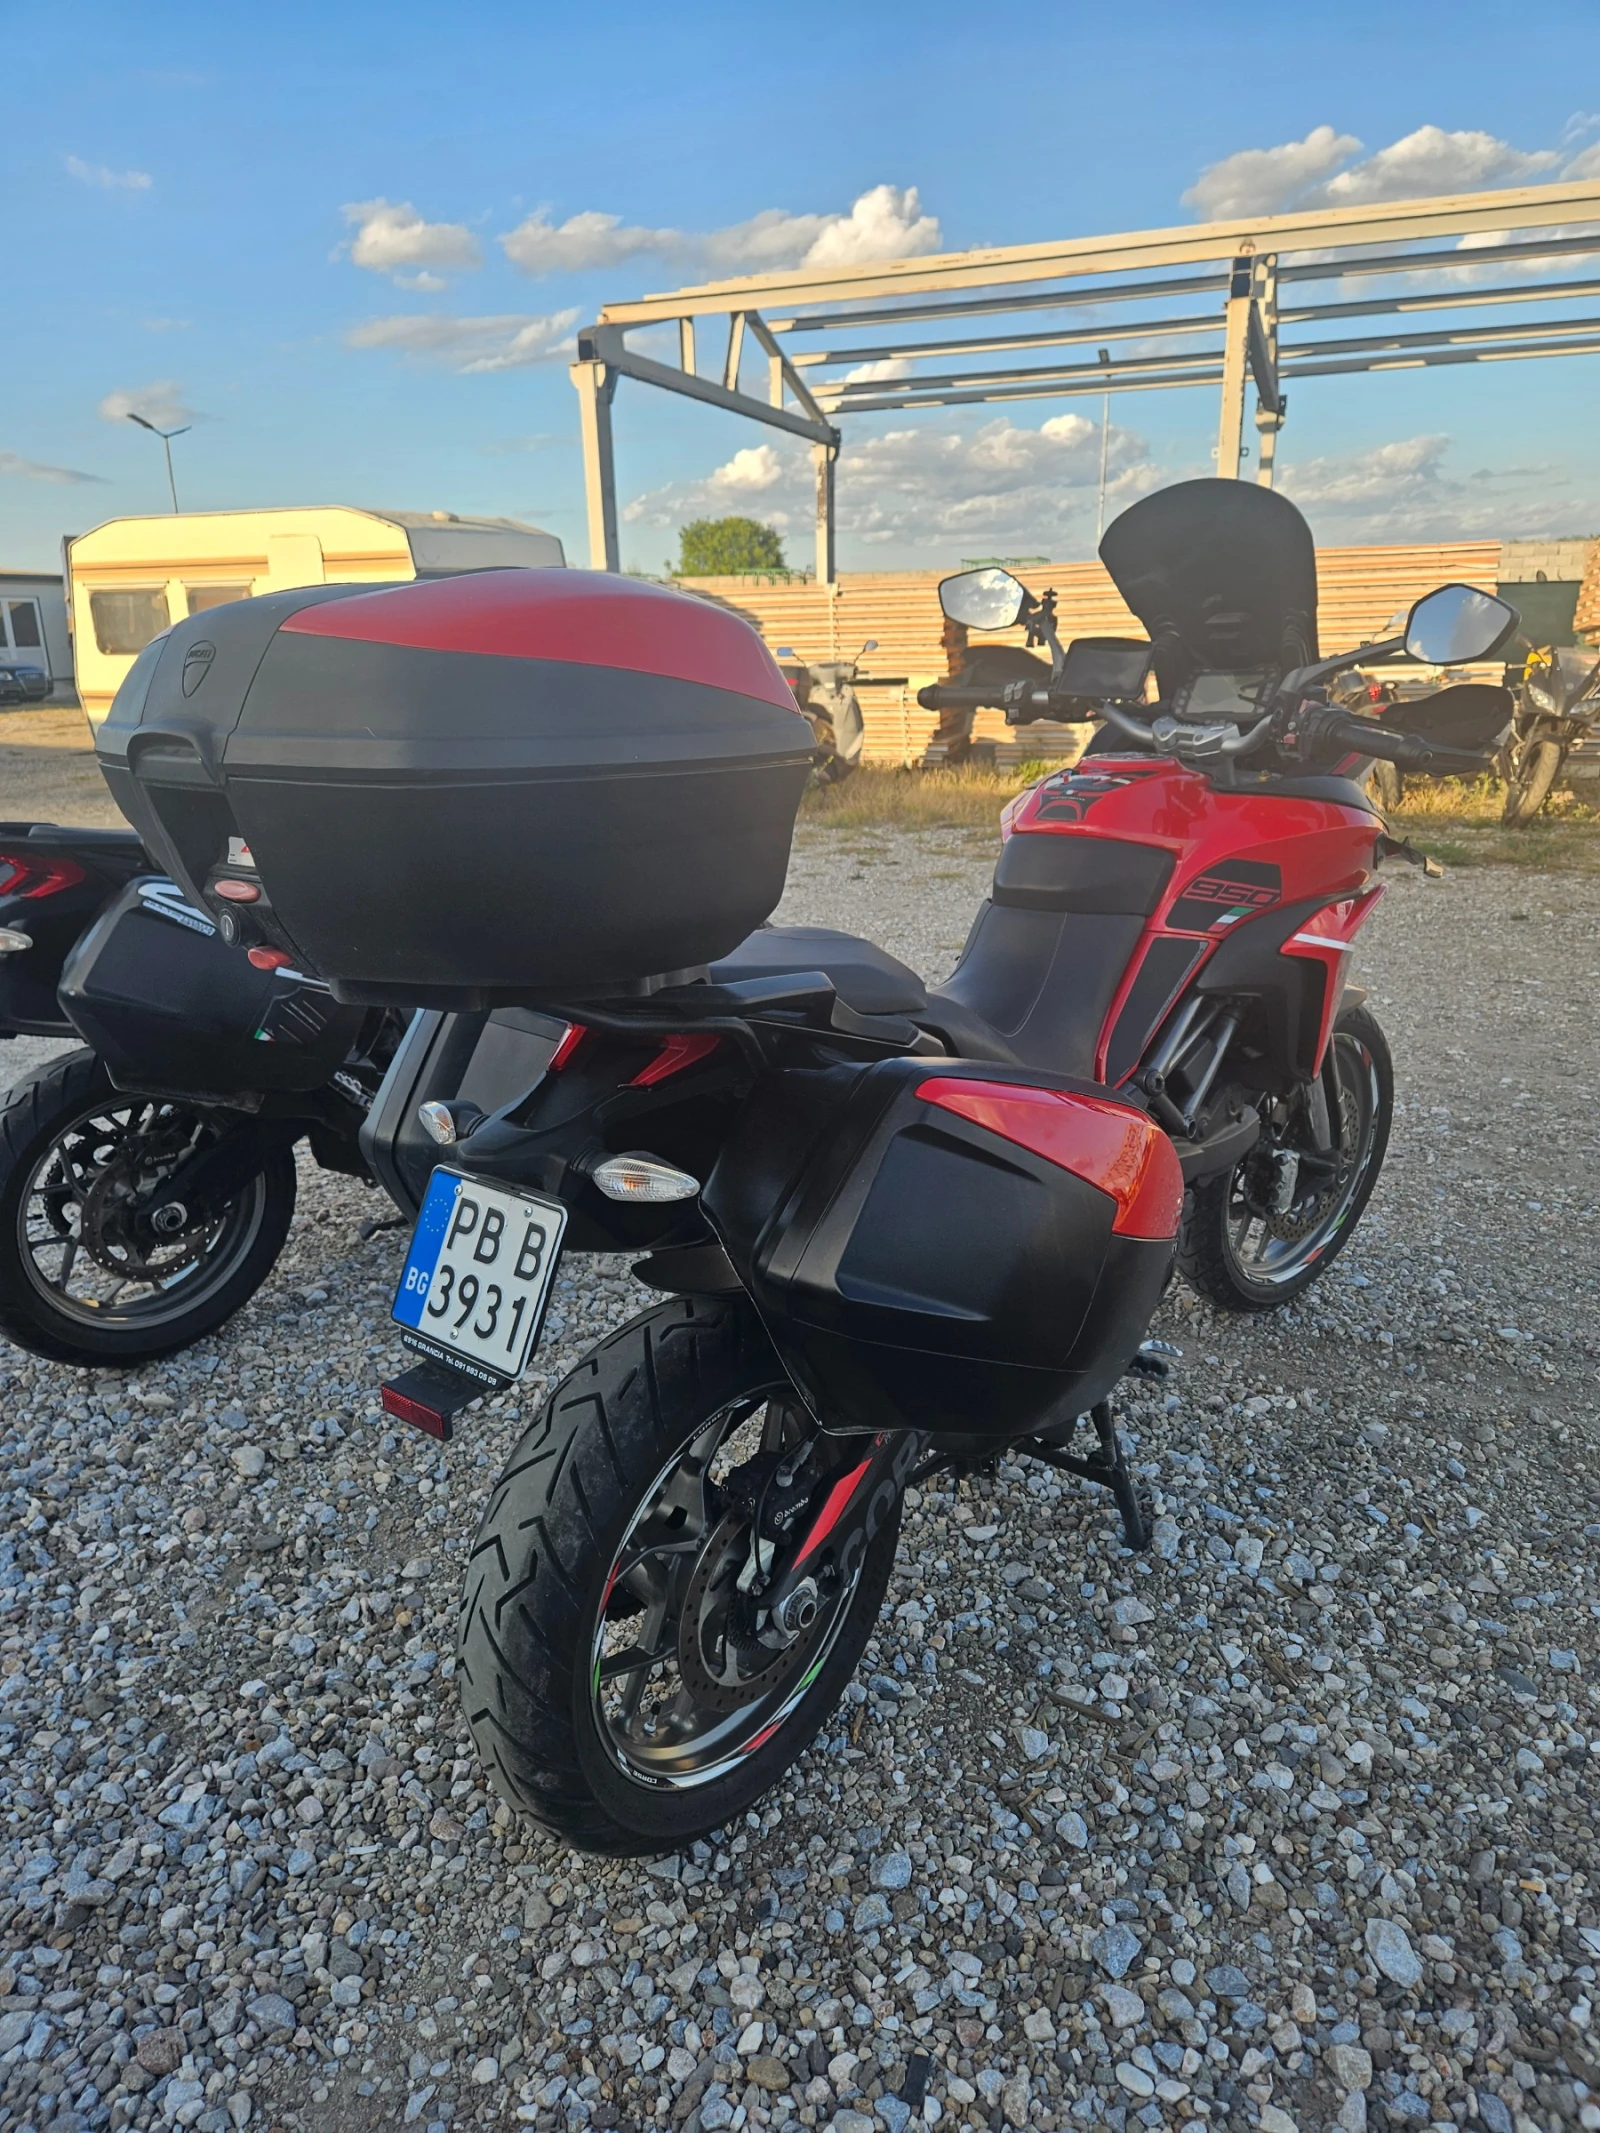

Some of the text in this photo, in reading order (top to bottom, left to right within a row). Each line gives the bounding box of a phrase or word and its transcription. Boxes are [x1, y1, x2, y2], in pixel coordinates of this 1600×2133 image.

[1186, 880, 1279, 905] 950
[446, 1197, 547, 1281] PB B
[405, 1266, 429, 1295] BG
[427, 1264, 527, 1353] 3931
[417, 1341, 444, 1360] GRANCIA
[783, 1497, 809, 1518] brembo
